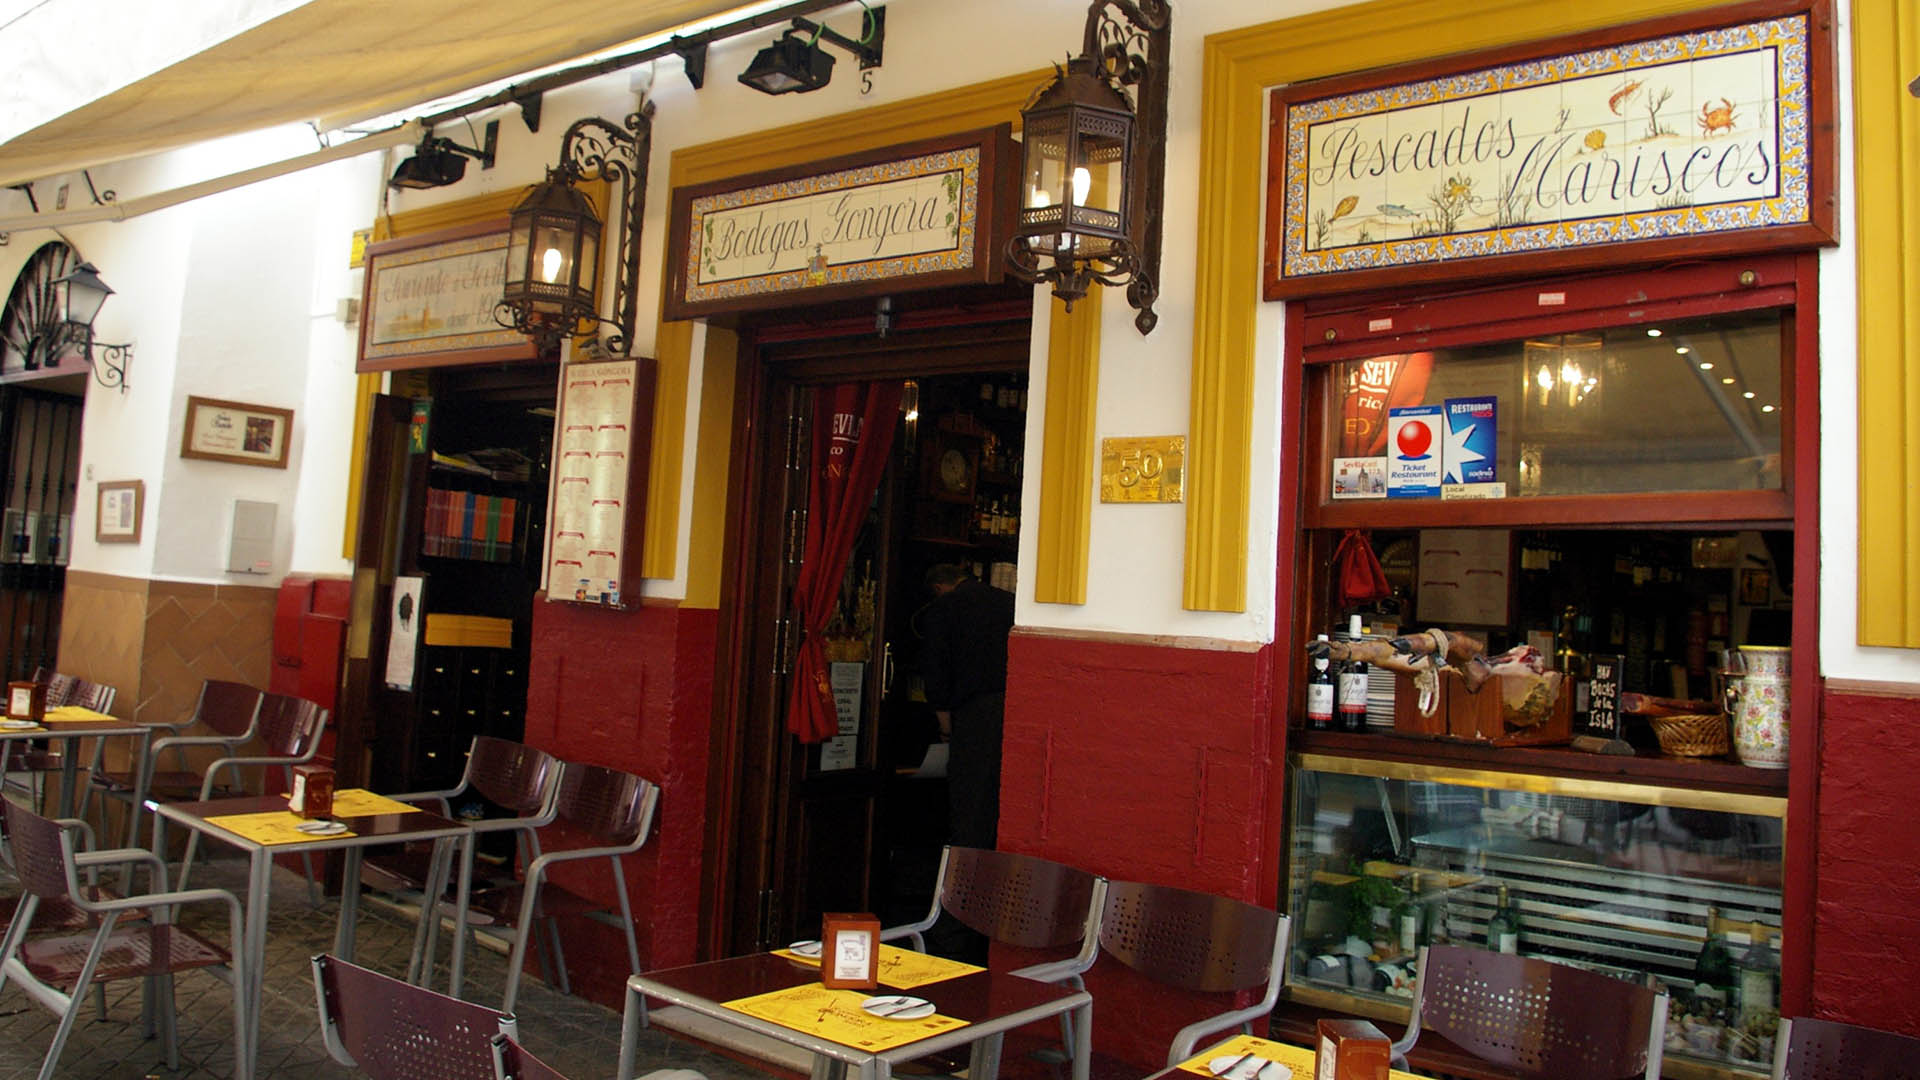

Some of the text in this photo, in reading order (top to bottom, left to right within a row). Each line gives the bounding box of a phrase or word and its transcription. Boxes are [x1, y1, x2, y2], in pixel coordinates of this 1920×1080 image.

[860, 71, 873, 95] 5
[1312, 106, 1515, 186] Pescados
[1470, 132, 1770, 216] Mariscos
[714, 210, 810, 271] Bodegas
[1119, 448, 1163, 488] 50
[1391, 471, 1437, 479] Restaurant
[1402, 464, 1427, 472] Ticket
